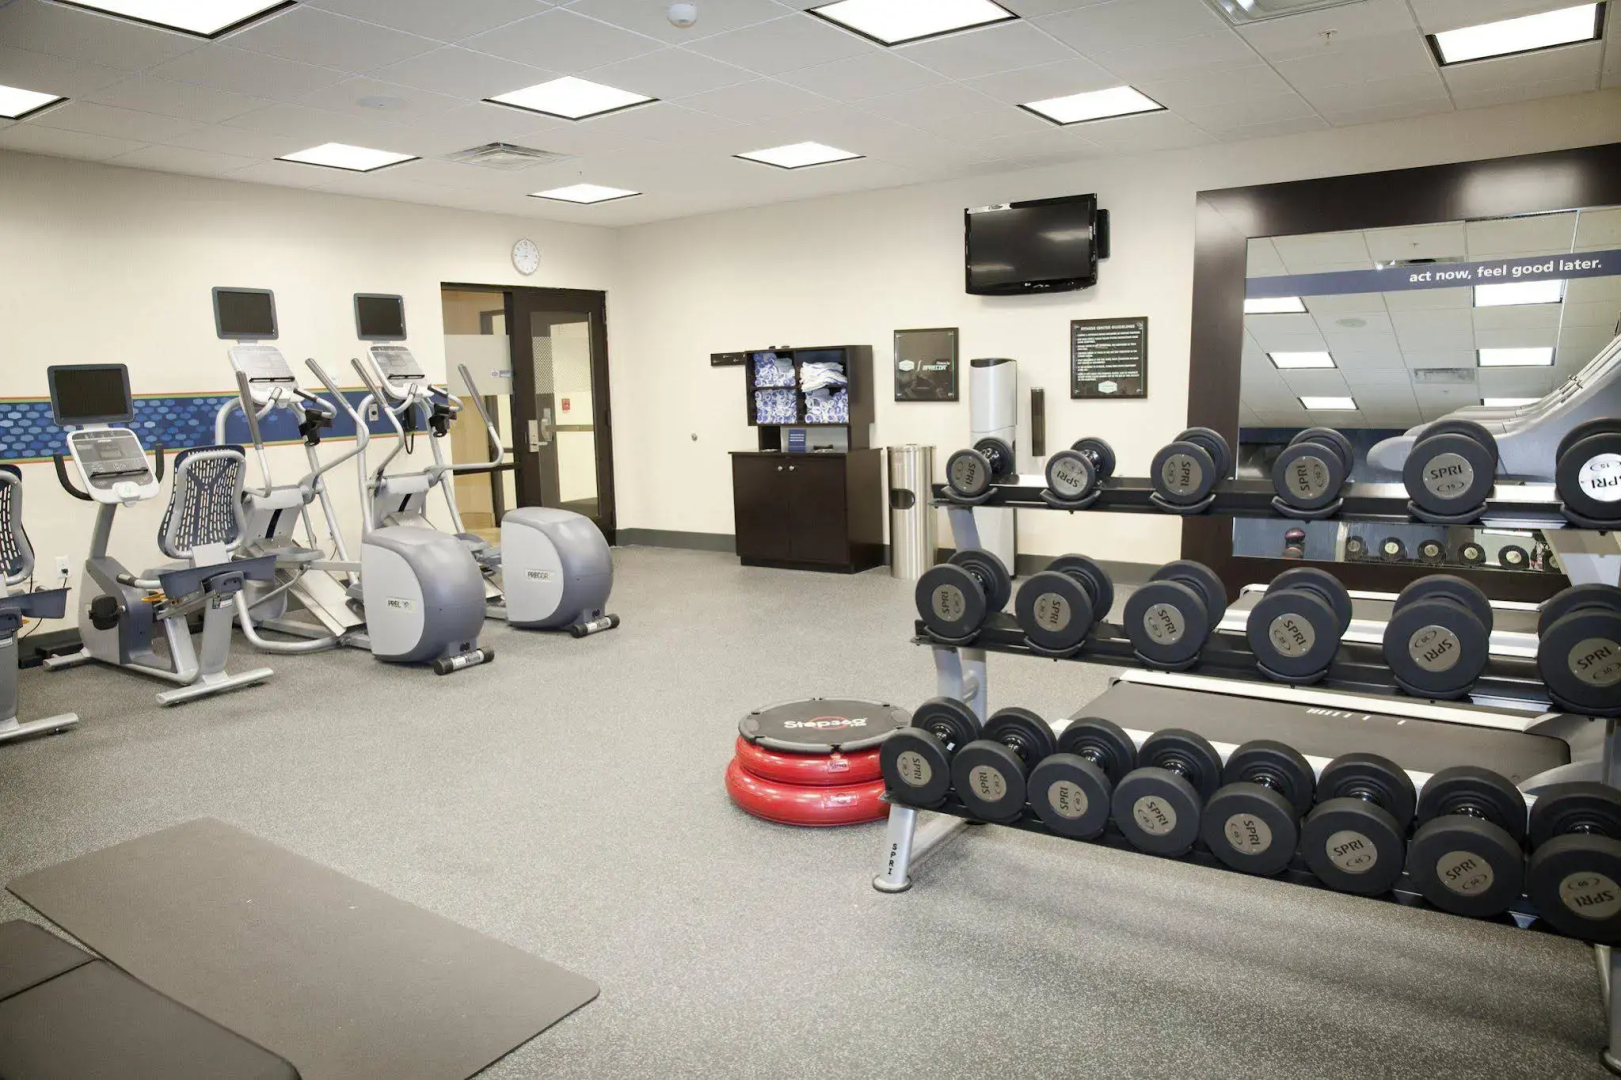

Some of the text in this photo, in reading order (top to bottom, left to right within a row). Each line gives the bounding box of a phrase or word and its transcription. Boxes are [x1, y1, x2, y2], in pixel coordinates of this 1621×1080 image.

[1409, 259, 1602, 283] act now, feel good later.
[966, 462, 976, 486] SPRI
[1057, 470, 1080, 488] SPRI
[1180, 461, 1191, 487] SPRI
[1297, 465, 1310, 491] SPRI
[1430, 464, 1463, 479] SPRI
[1591, 475, 1621, 489] PRI
[941, 591, 949, 614] SPRI
[1050, 601, 1061, 625] SPRI
[1157, 609, 1177, 635] SPRI
[1283, 620, 1306, 646] SPRI
[1423, 638, 1453, 662] SPRI
[1577, 646, 1612, 670] SPRI
[784, 718, 866, 729] Step360
[912, 757, 921, 780] SPRI
[978, 772, 990, 794] SPRI
[1059, 787, 1070, 810] SPRI
[1147, 801, 1168, 826] SPRI
[1243, 820, 1261, 846] SPRI
[888, 843, 897, 875] SPRI
[1333, 839, 1364, 856] SPRI
[1445, 858, 1477, 881] SPRI
[1574, 890, 1614, 907] SPRI
